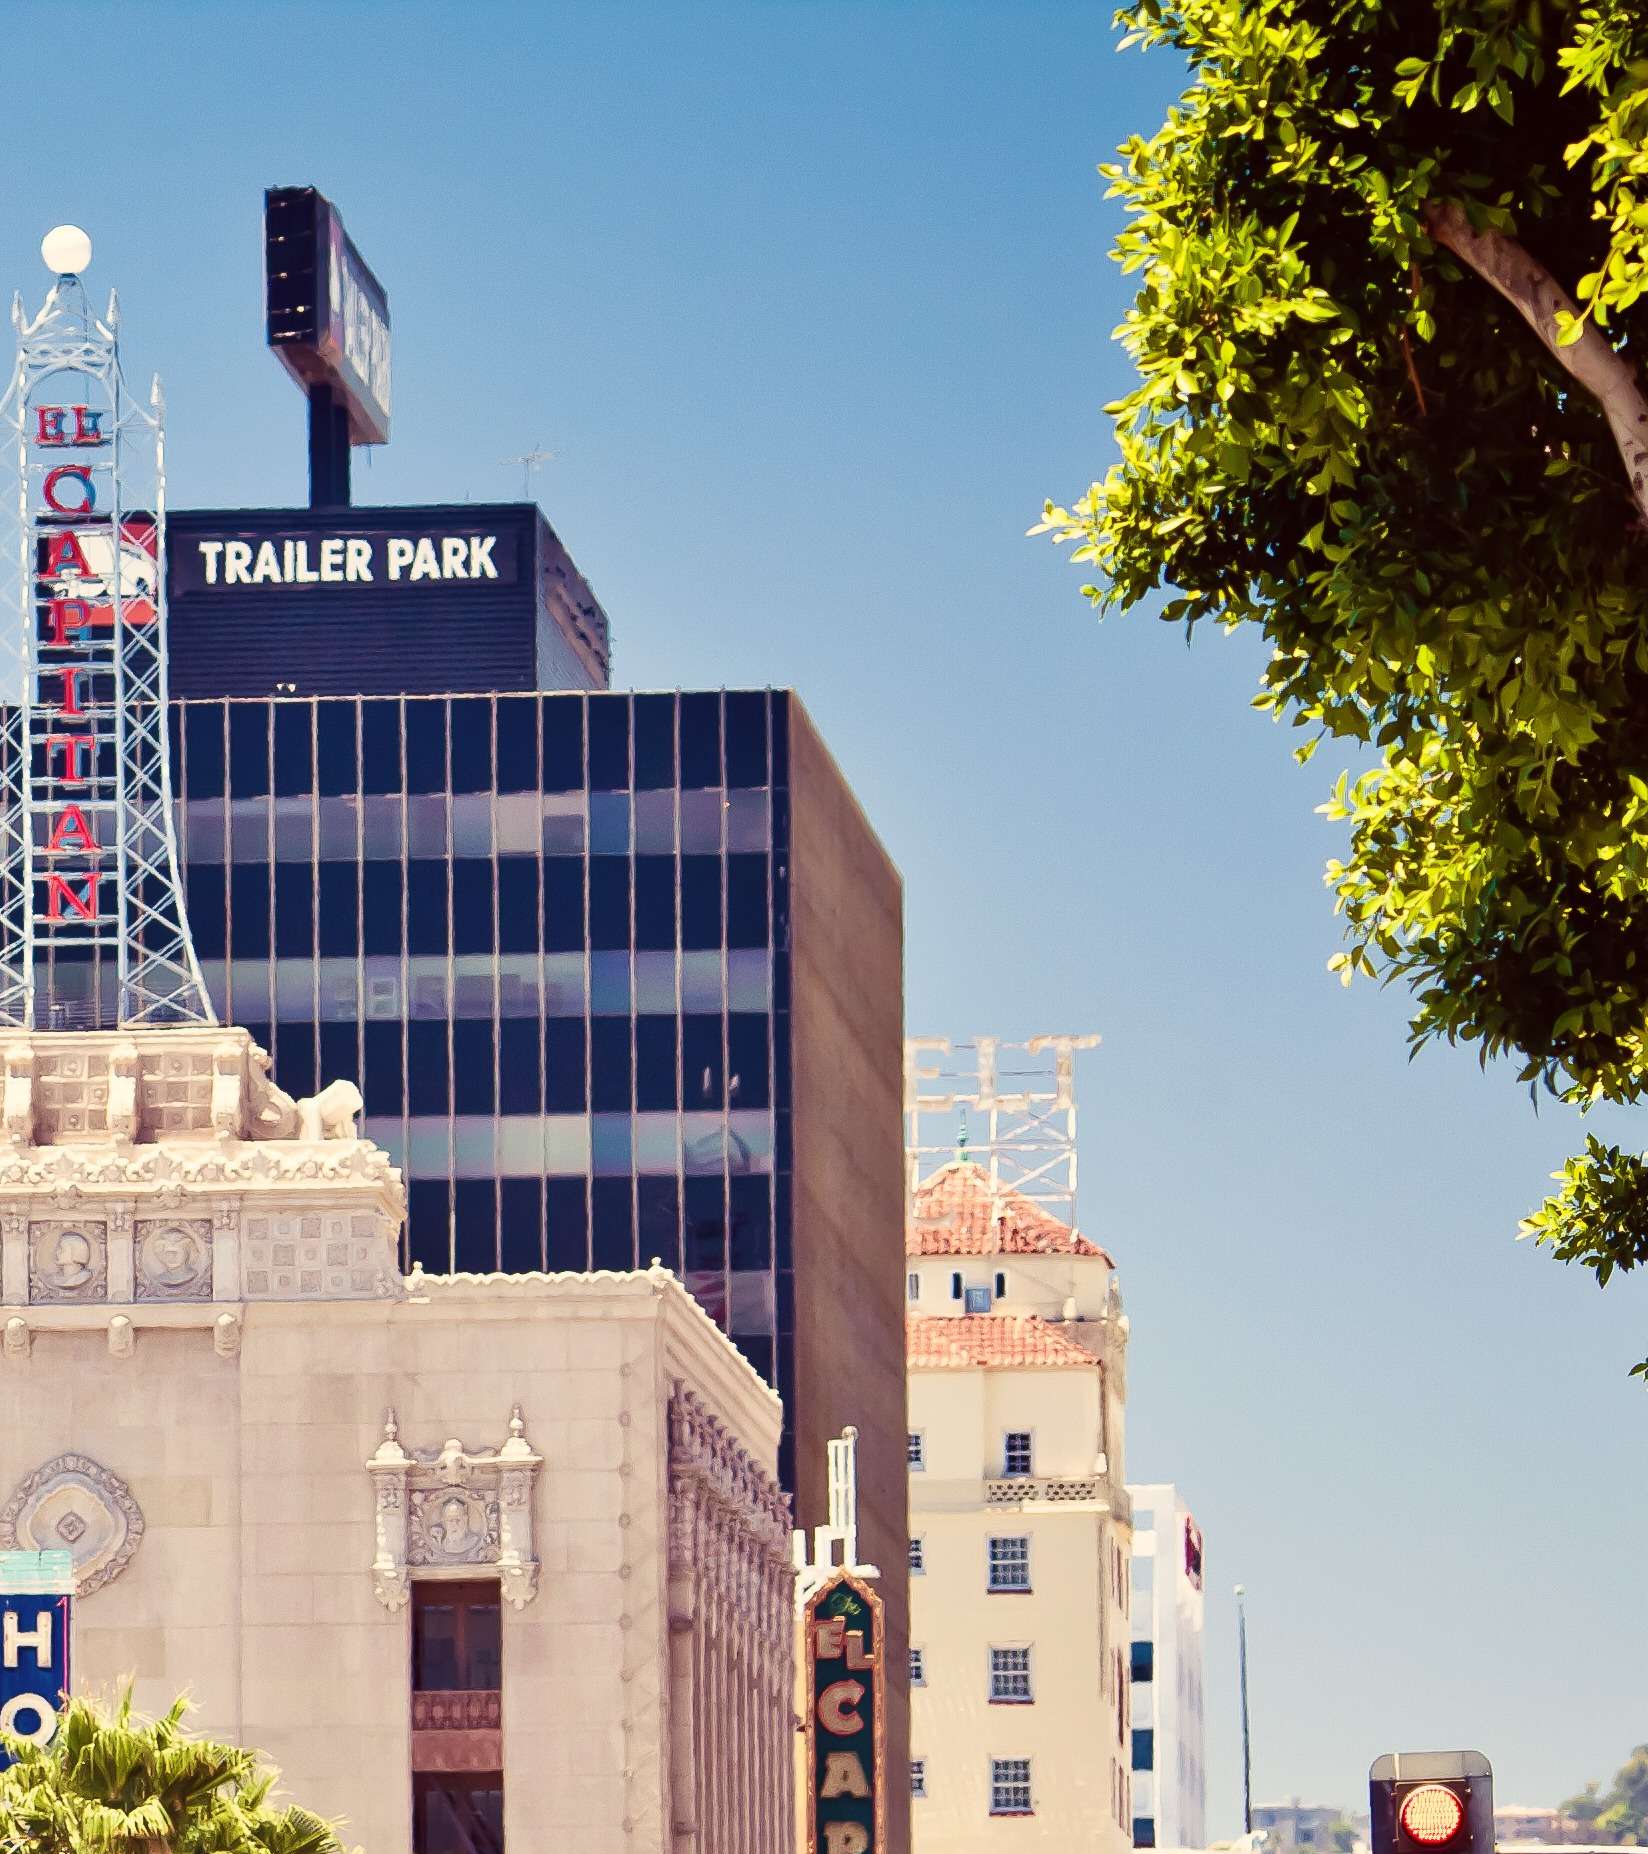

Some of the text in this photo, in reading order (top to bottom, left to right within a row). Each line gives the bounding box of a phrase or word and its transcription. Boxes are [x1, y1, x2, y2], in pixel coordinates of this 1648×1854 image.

[199, 535, 497, 586] TRAILER PARK
[43, 464, 100, 921] CAPITAN
